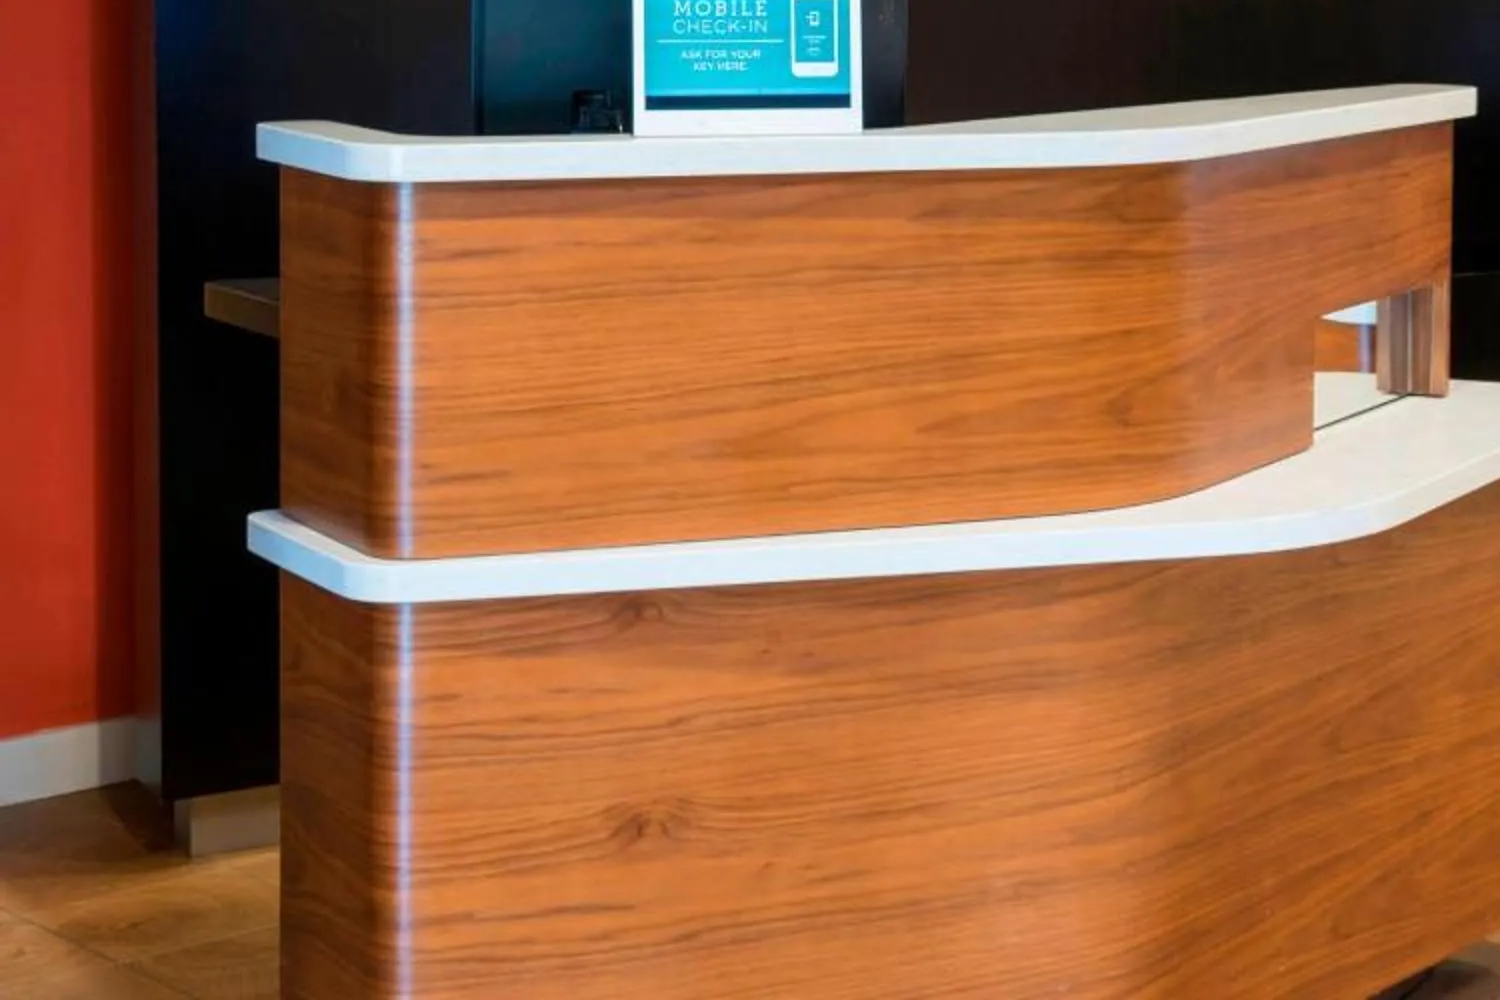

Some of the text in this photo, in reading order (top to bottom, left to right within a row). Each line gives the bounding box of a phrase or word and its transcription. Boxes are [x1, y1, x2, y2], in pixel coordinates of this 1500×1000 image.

[674, 0, 768, 17] MOBILE
[673, 19, 768, 34] CHECK-IN
[705, 49, 727, 60] FOR
[731, 49, 761, 60] YOUR
